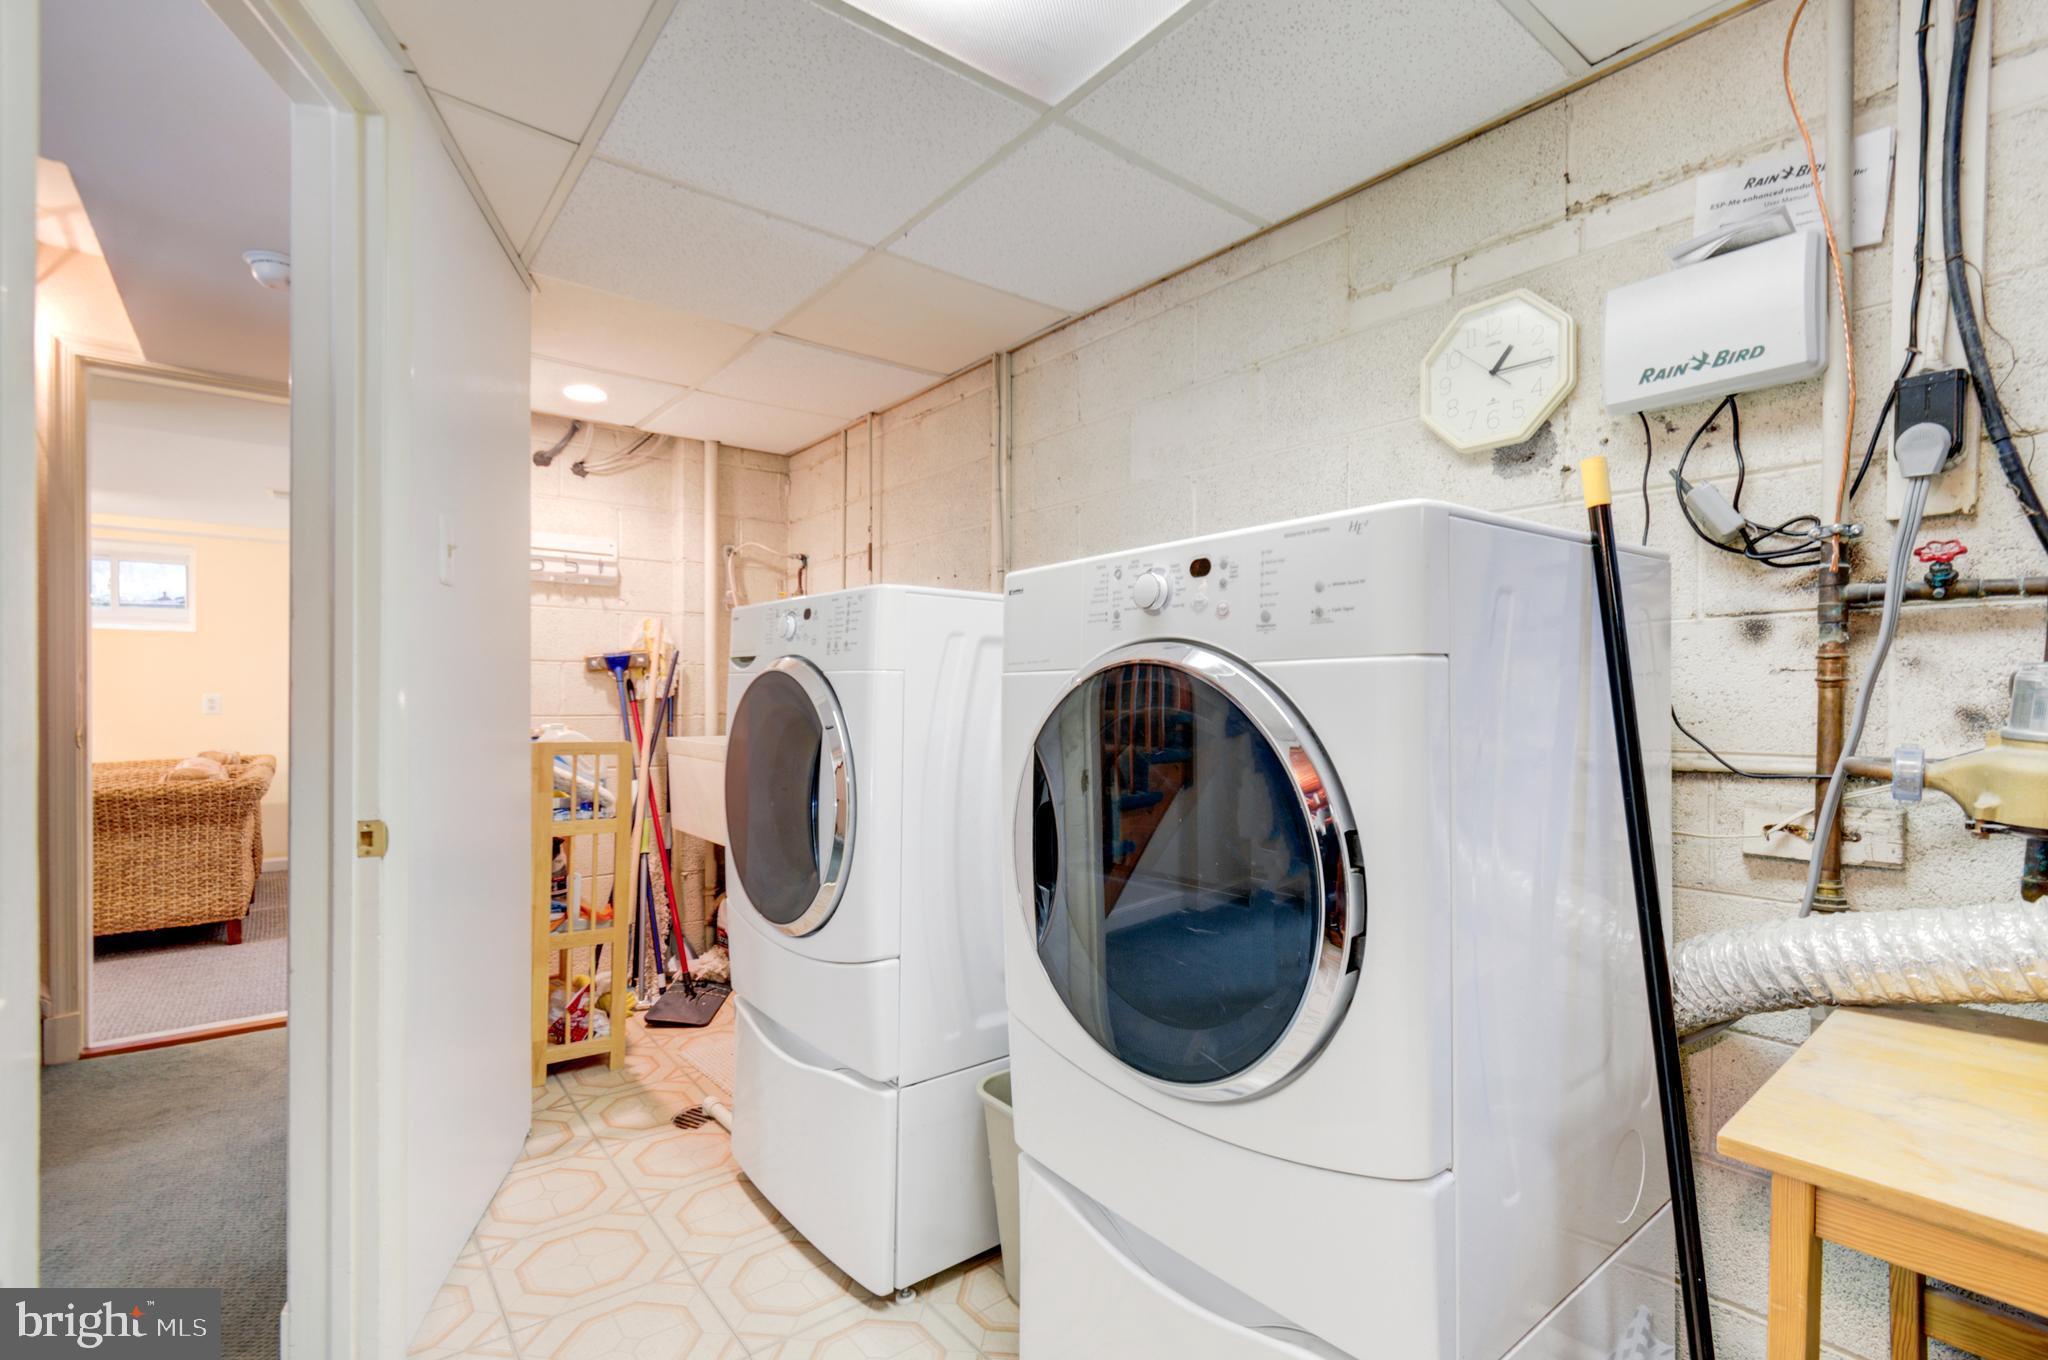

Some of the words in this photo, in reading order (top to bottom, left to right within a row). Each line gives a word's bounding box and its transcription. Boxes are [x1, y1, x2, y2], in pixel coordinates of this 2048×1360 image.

[1743, 173, 1780, 190] RAIN
[1742, 188, 1784, 203] enhanced
[1763, 199, 1780, 208] User
[1781, 193, 1809, 204] Manual
[1485, 316, 1503, 338] 12
[1532, 324, 1545, 345] 2
[1465, 328, 1477, 348] 11
[1444, 351, 1463, 372] 10
[1638, 362, 1691, 385] RAIN
[1711, 345, 1766, 368] BIRD
[1439, 377, 1452, 396] 9
[1531, 376, 1544, 397] 4
[1446, 399, 1460, 418] 8
[1511, 399, 1525, 419] 5
[1465, 409, 1478, 431] 7
[1486, 409, 1500, 430] 6
